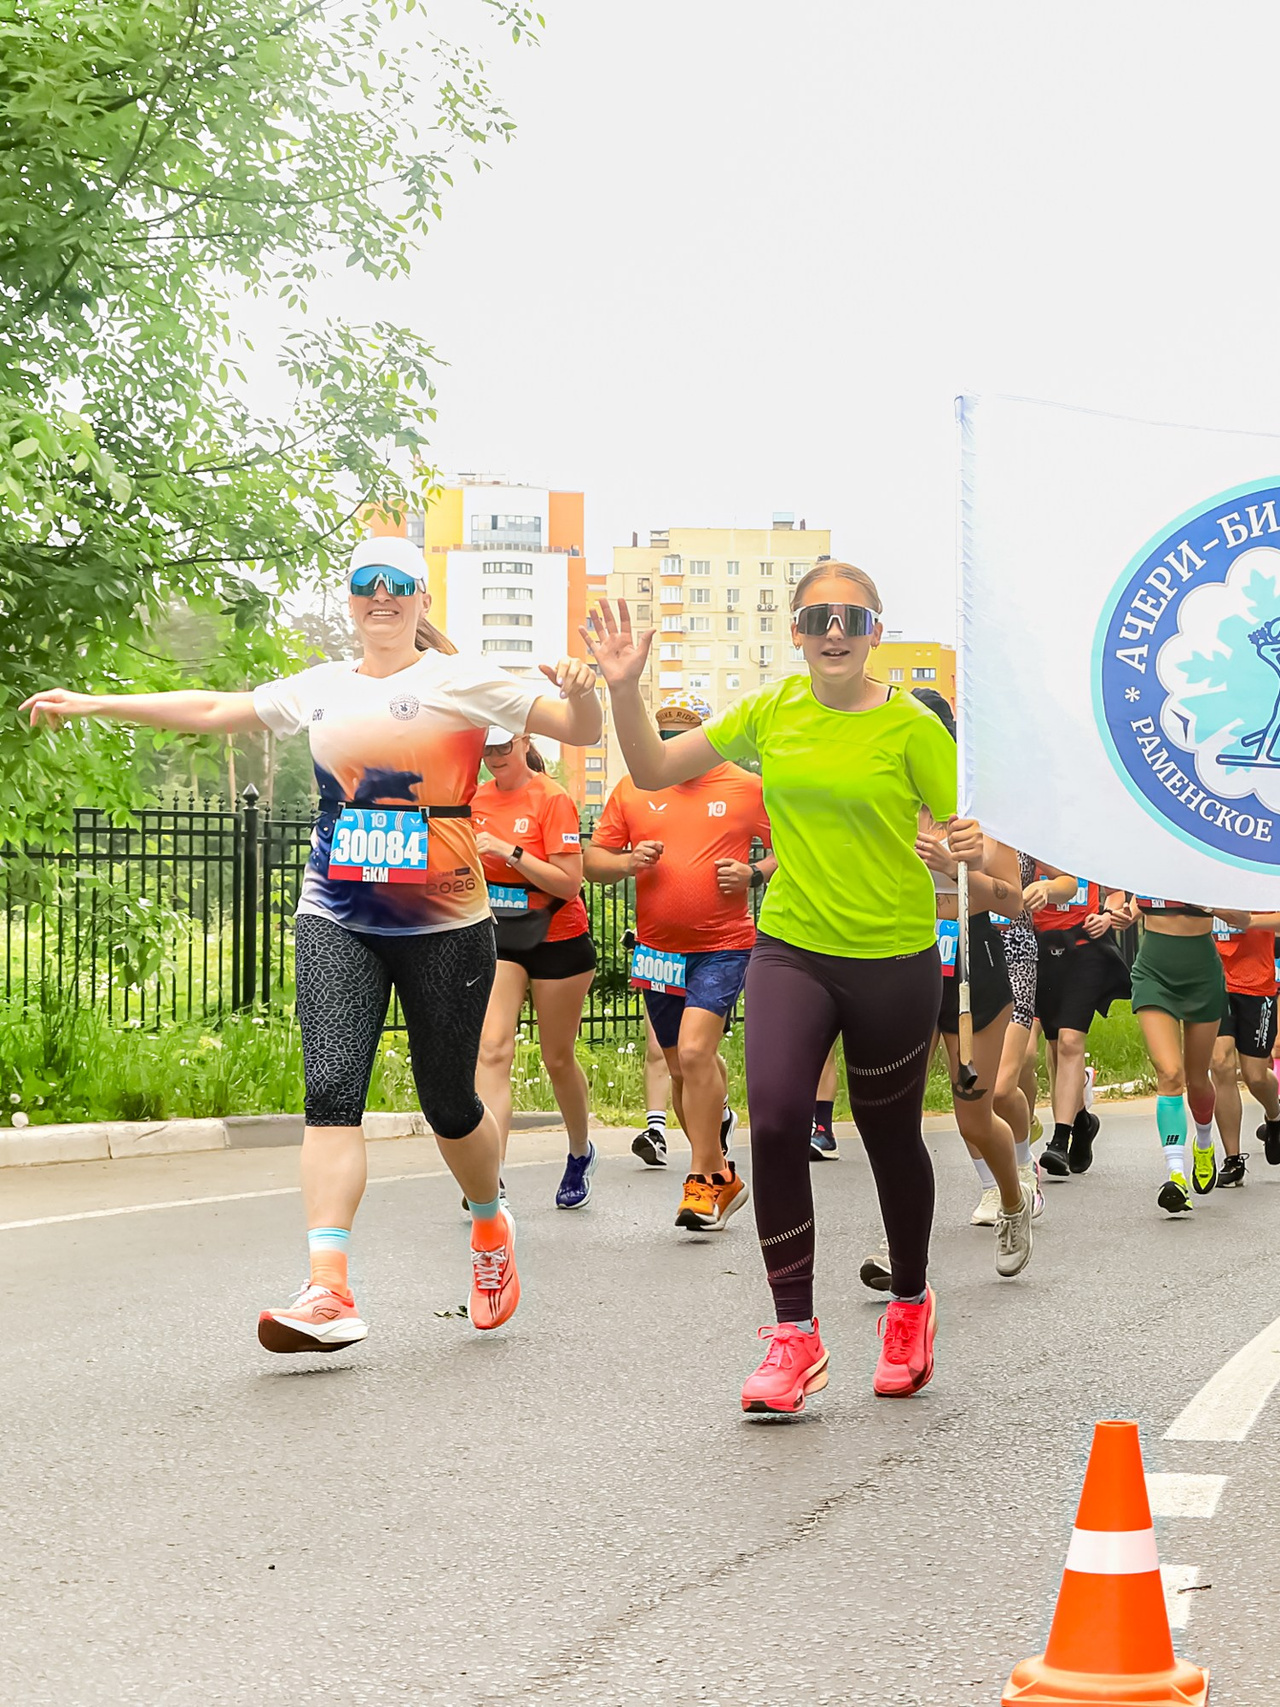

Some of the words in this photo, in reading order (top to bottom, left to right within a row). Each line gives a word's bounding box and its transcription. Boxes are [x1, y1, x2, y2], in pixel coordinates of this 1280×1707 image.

[676, 711, 696, 722] RIDE
[1130, 717, 1273, 843] РАМЕНСКОЕ
[707, 801, 727, 818] 10
[513, 817, 530, 834] 10
[335, 827, 422, 866] 30084
[361, 867, 389, 883] 5KM
[425, 877, 476, 896] 2026
[634, 953, 684, 986] 30007
[650, 980, 666, 993] 5KM
